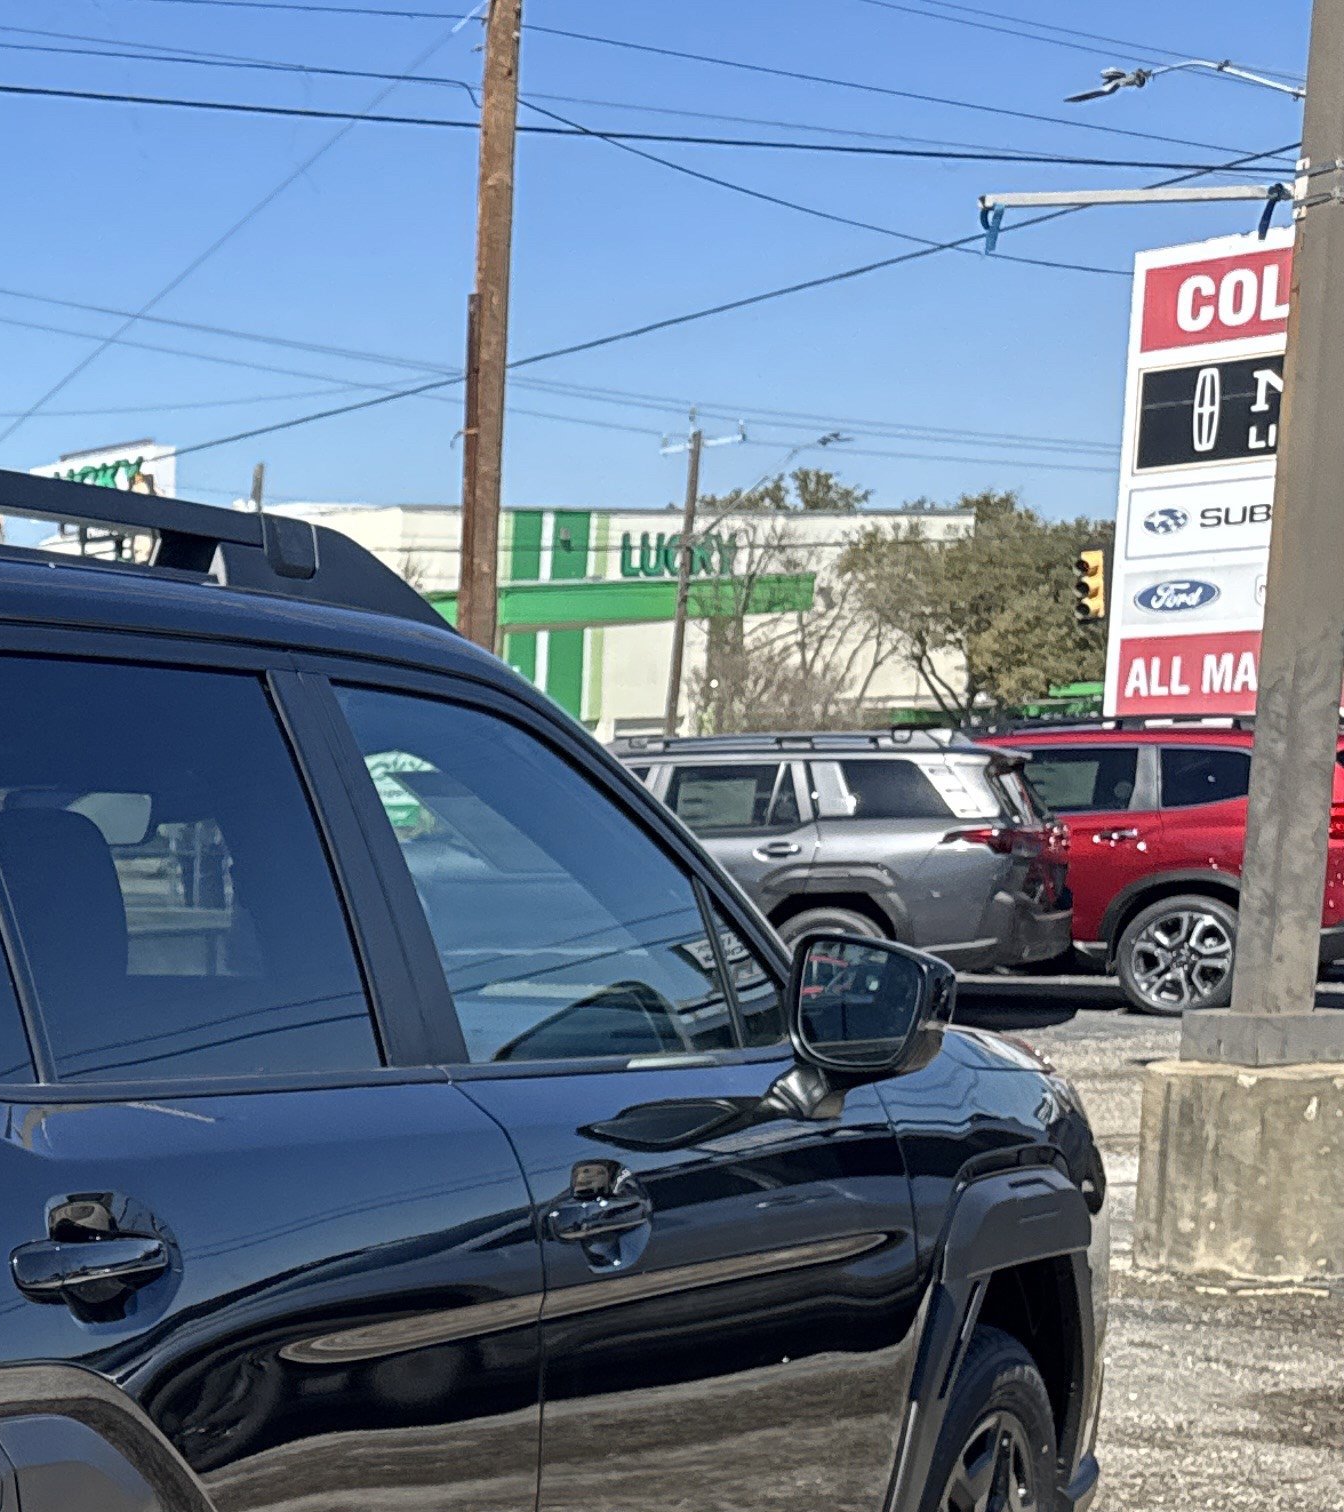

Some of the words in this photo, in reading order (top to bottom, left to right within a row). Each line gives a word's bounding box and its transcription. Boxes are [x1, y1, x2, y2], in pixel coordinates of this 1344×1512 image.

[1176, 263, 1290, 333] COL
[1199, 503, 1272, 528] SUB
[1150, 582, 1203, 609] Ford
[1124, 655, 1191, 697] ALL
[1201, 651, 1258, 693] MA
